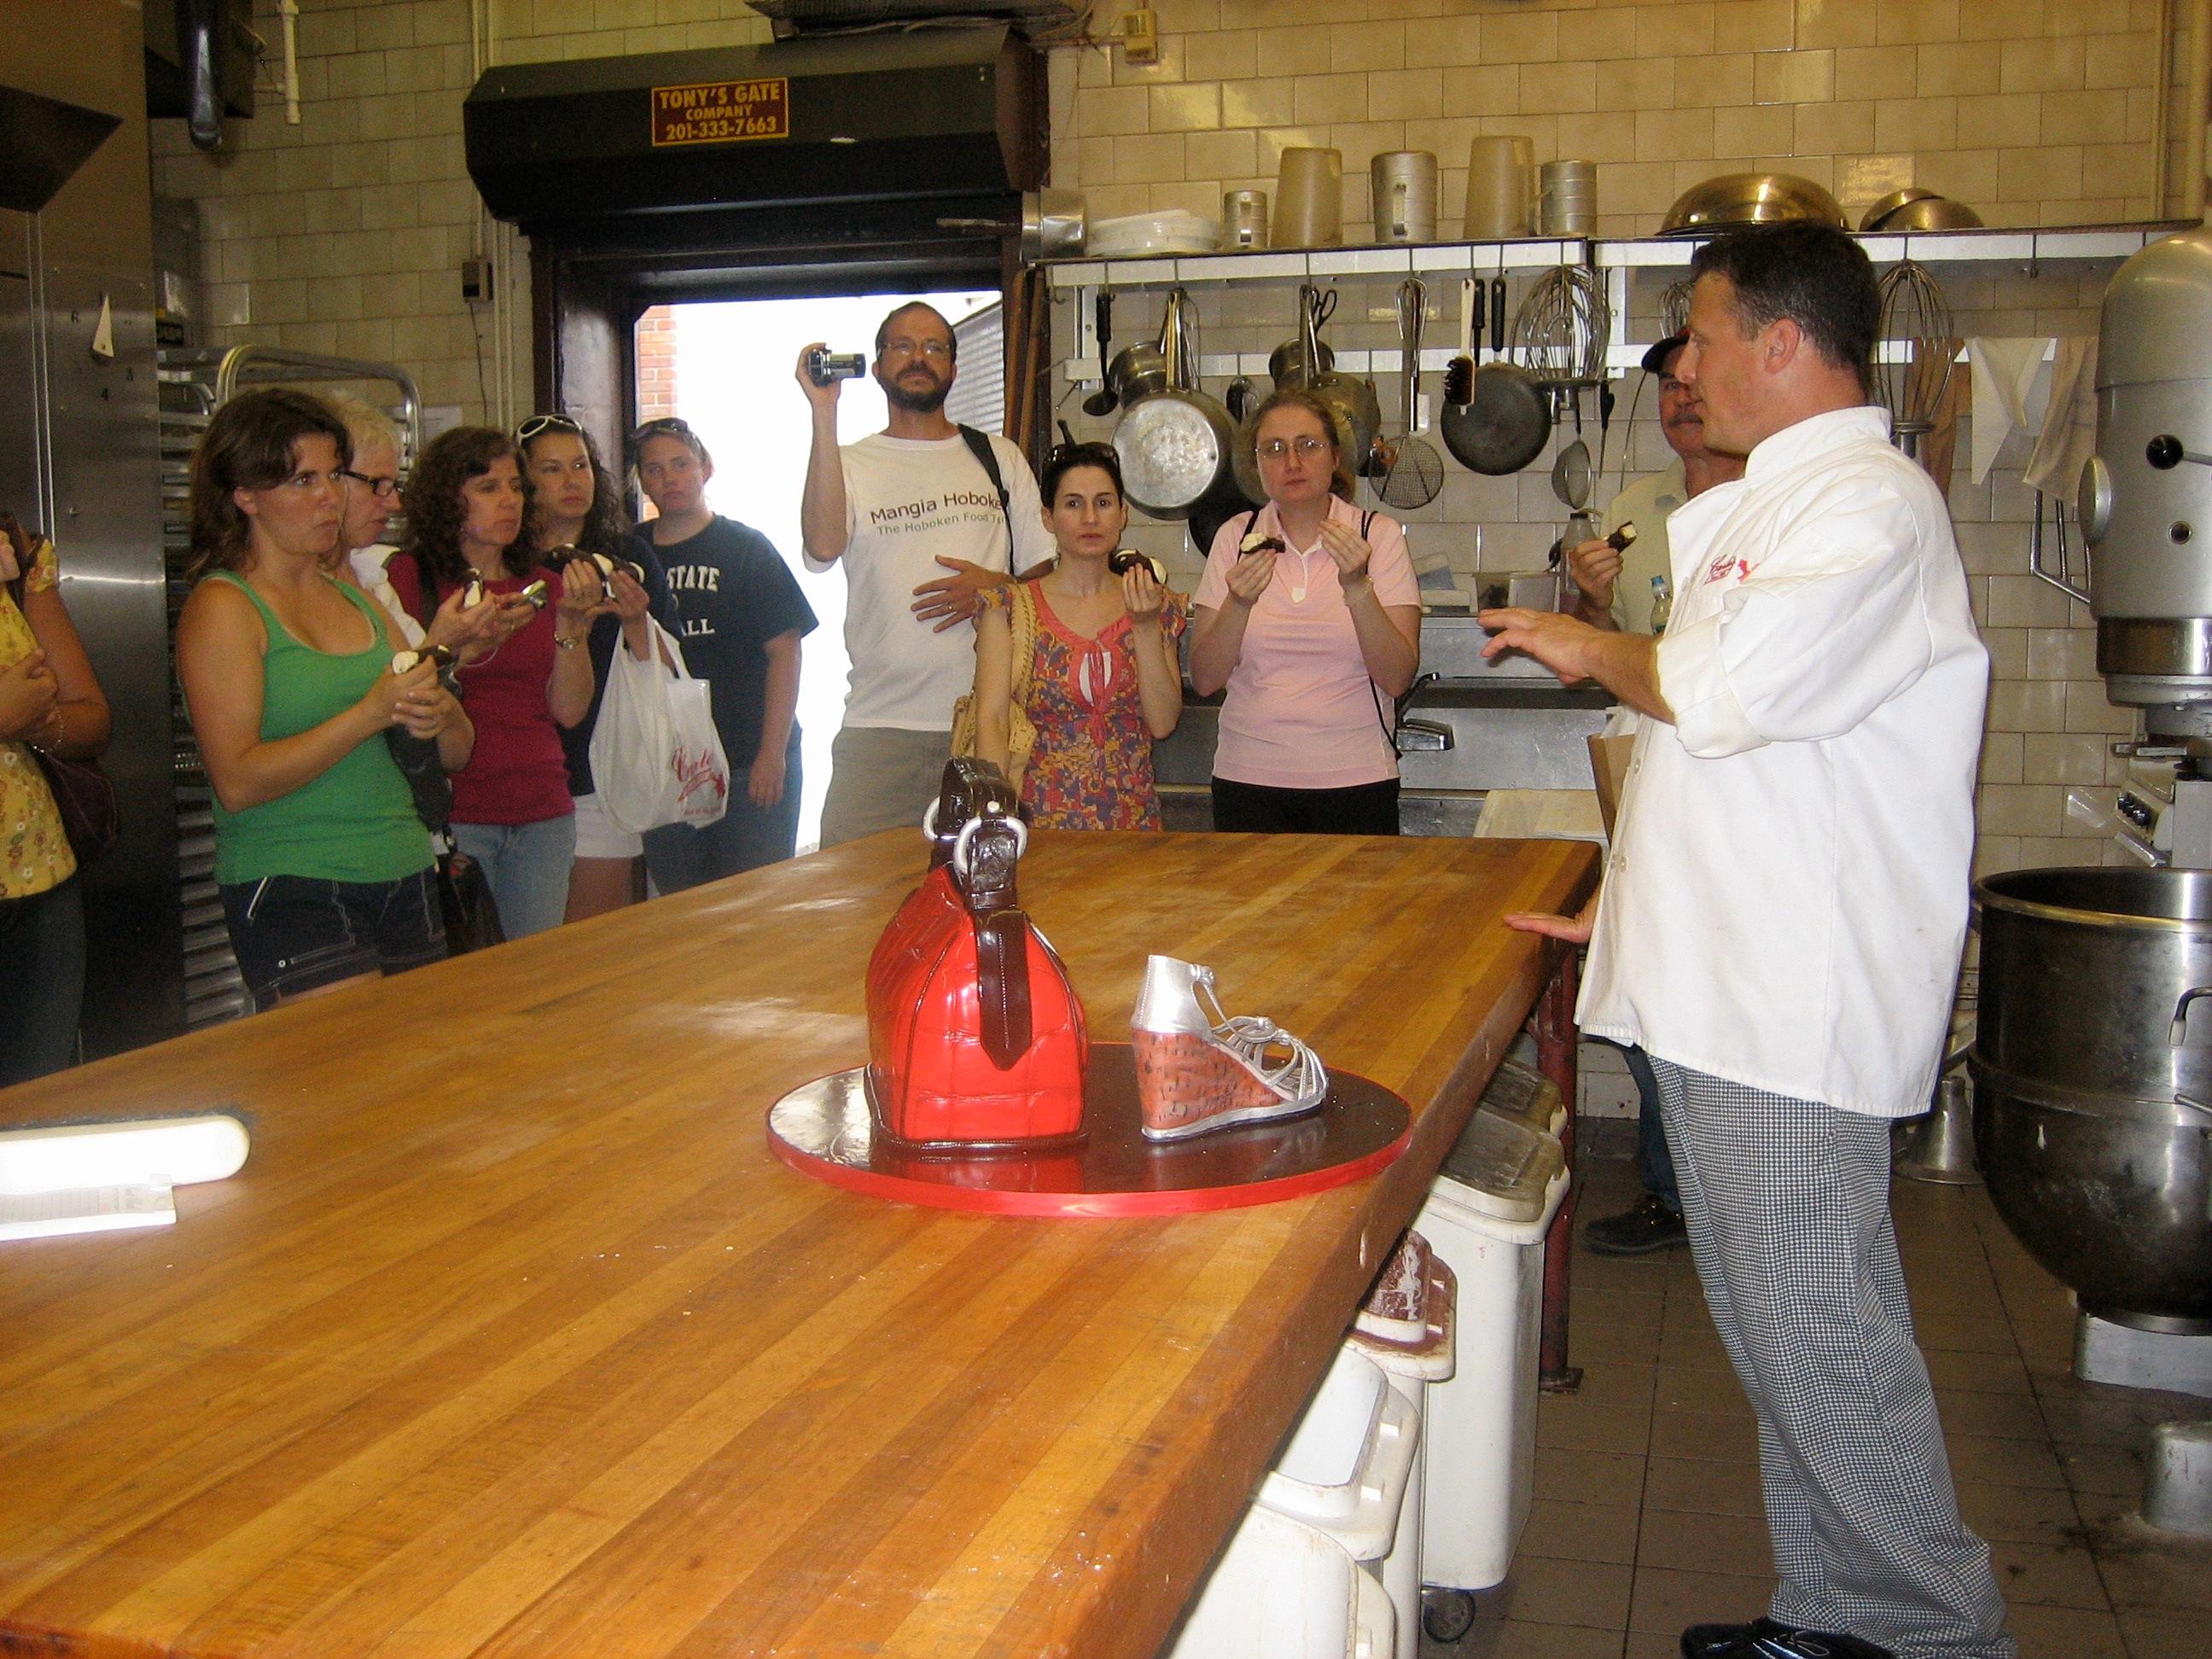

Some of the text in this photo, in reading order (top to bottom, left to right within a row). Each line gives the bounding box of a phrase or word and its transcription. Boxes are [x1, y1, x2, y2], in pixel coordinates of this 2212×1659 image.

[660, 82, 780, 109] TONY'S GATE
[685, 103, 753, 121] COMPANY
[666, 115, 777, 141] 201-333-7663
[870, 491, 1003, 524] Mangia Hoboke
[878, 525, 901, 536] The
[905, 515, 959, 533] Hoboken
[667, 564, 721, 592] STATE
[681, 617, 716, 637] LL
